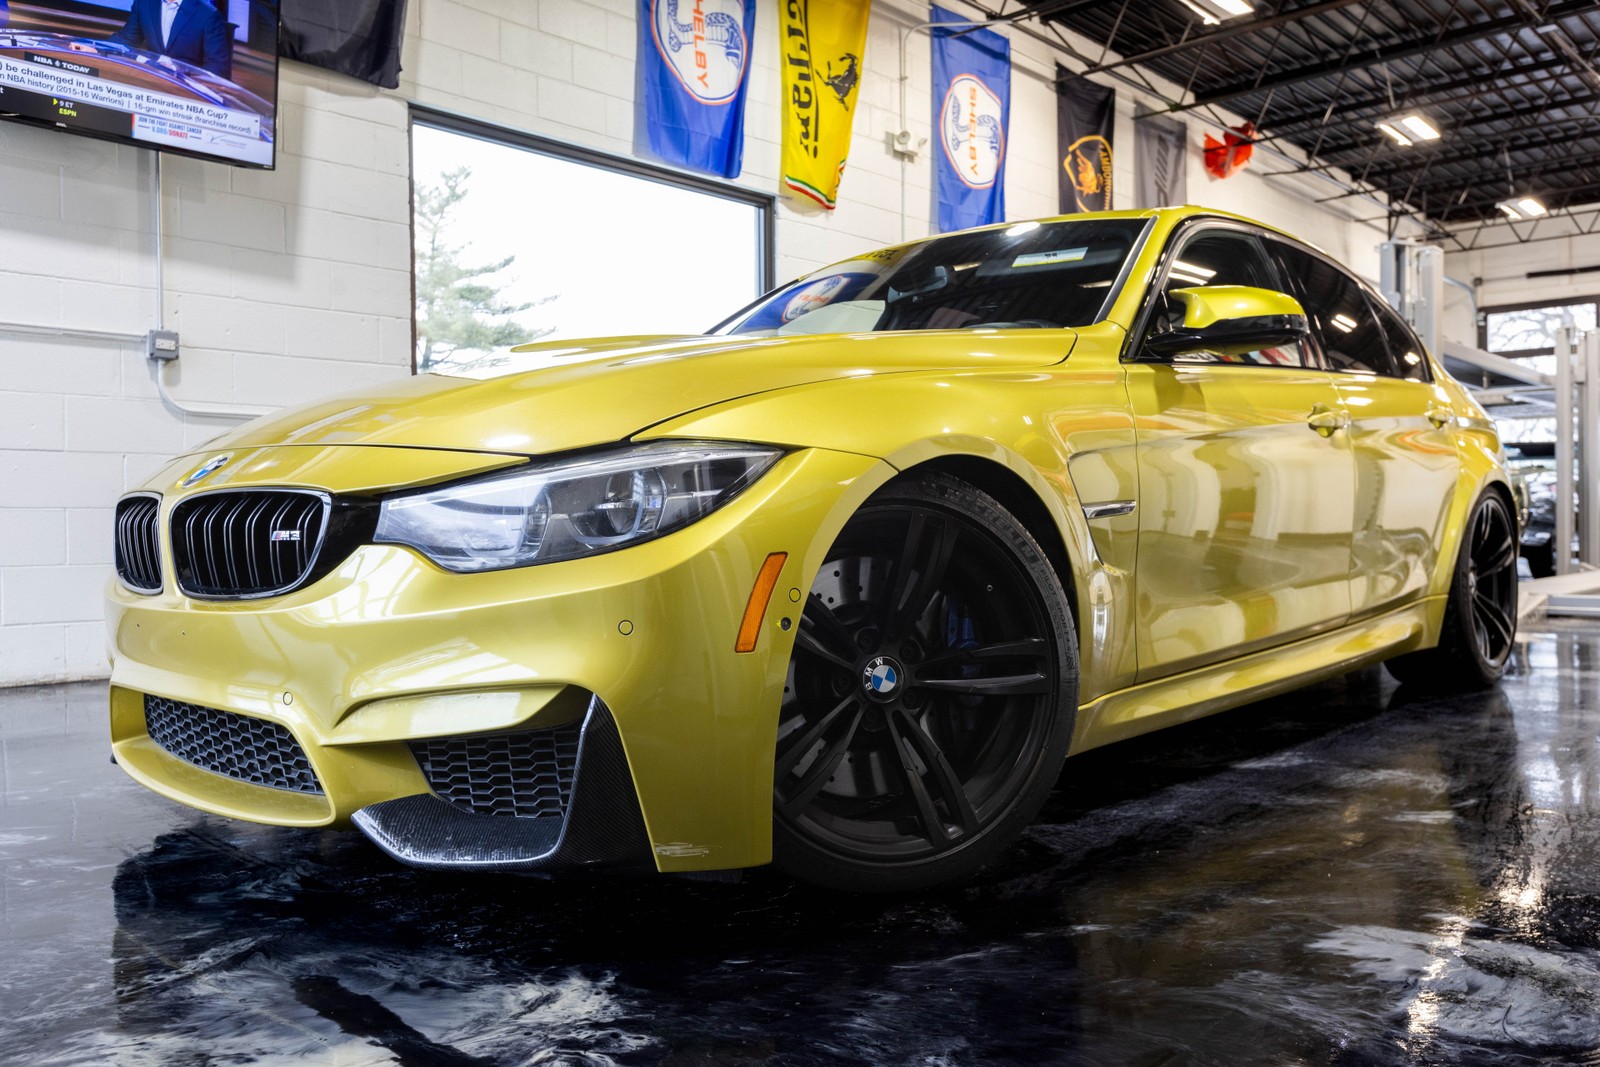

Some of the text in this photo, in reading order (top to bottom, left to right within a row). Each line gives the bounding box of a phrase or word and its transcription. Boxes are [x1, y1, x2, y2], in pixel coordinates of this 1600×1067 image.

[34, 55, 90, 73] NBA TODAY
[787, 0, 819, 159] errari
[5, 63, 18, 73] be
[21, 68, 73, 84] challenged
[76, 80, 85, 88] in
[87, 81, 103, 93] Las
[106, 86, 133, 99] Vegas
[135, 93, 144, 102] at
[146, 95, 184, 109] Emirates
[186, 104, 205, 115] NBA
[207, 109, 228, 120] Cup?
[7, 74, 26, 84] NBA
[28, 77, 54, 91] history
[56, 85, 90, 98] (2015-16
[91, 92, 125, 107] Warriors)
[134, 102, 157, 114] 16-gm
[158, 108, 171, 116] win
[172, 111, 194, 121] streak
[194, 115, 228, 129] (franchise
[228, 123, 252, 134] record)
[59, 107, 77, 118] ESPN
[65, 101, 74, 109] ET
[969, 87, 979, 176] SHELBY
[277, 530, 301, 541] M3
[1039, 567, 1058, 598] PILOT
[1055, 600, 1070, 637] SPORT
[864, 656, 884, 691] BMW
